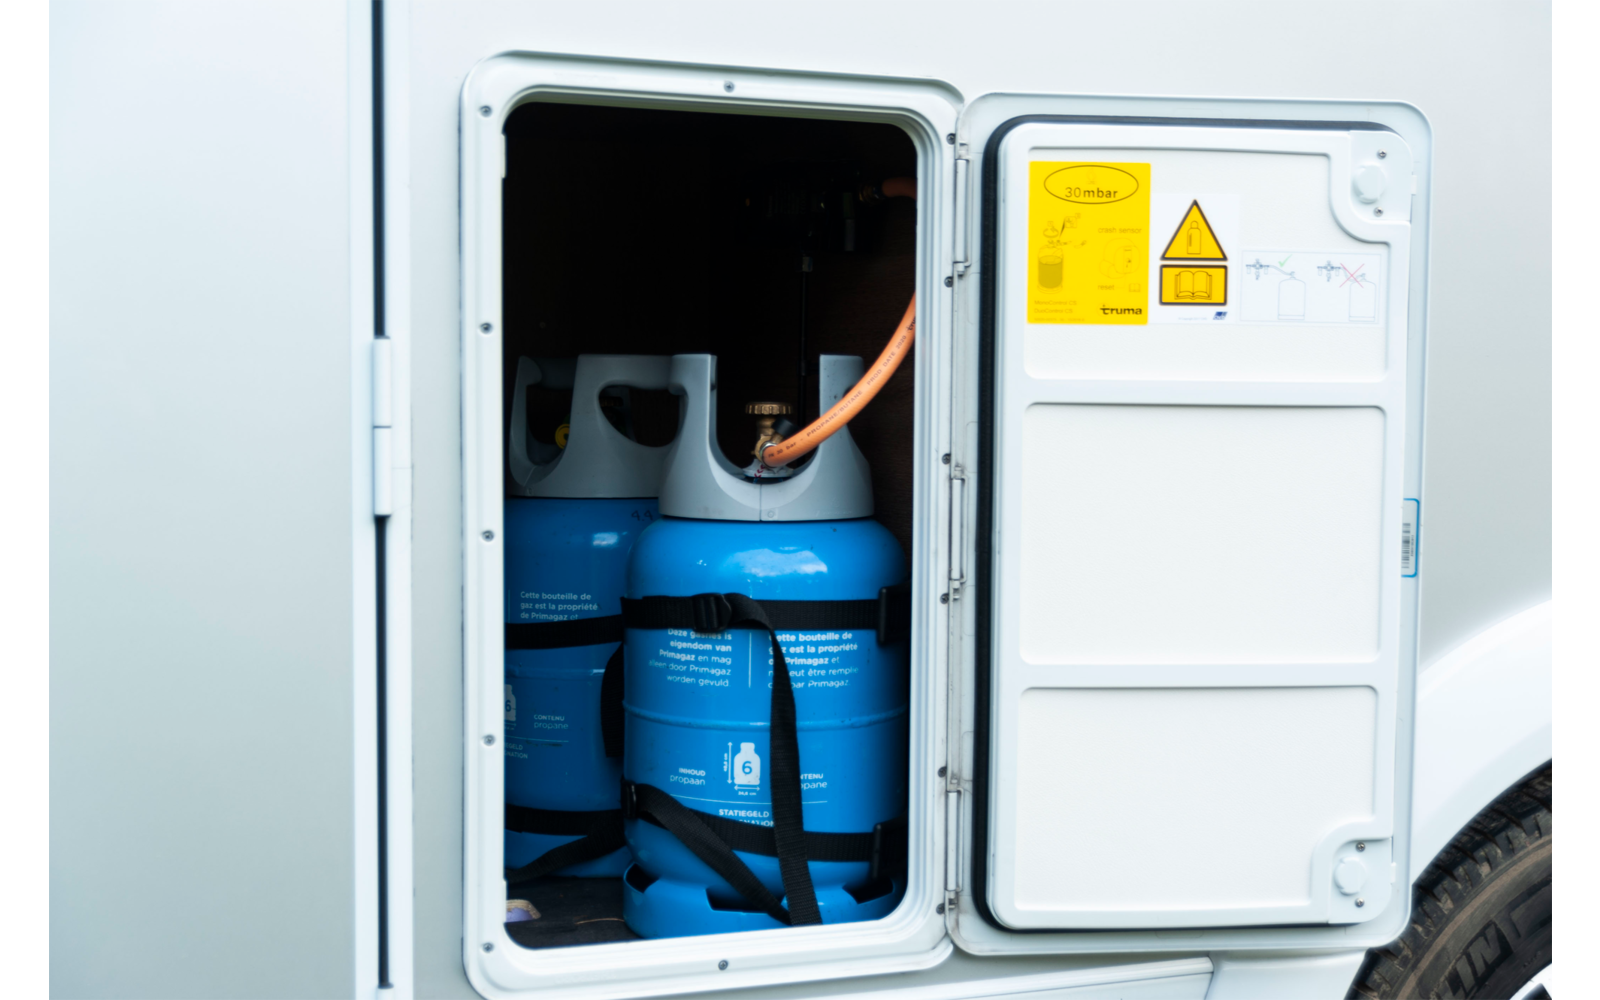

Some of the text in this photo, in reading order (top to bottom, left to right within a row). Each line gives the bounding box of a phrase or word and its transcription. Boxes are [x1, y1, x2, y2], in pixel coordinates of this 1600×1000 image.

[1100, 306, 1142, 315] truma
[786, 442, 796, 450] bar
[806, 390, 862, 437] PROPANE/BUTANE
[866, 368, 882, 386] PROD
[882, 351, 896, 368] DATE
[896, 335, 906, 350] 2020
[520, 591, 540, 599] Cette
[558, 603, 598, 611] propriété
[531, 612, 568, 621] Primagaz
[724, 632, 732, 640] is
[799, 632, 840, 642] bouteille
[670, 640, 712, 650] eigendom
[768, 642, 858, 655] gz est la propriété
[660, 649, 696, 661] Primagaz
[711, 656, 732, 665] mag
[784, 657, 829, 666] Primagaz
[668, 662, 687, 671] door
[690, 664, 731, 676] Primagaz
[808, 668, 826, 677] être
[828, 666, 858, 676] remplie
[666, 674, 696, 684] worden
[679, 768, 706, 776] INHOUD
[742, 760, 752, 774] 6
[670, 775, 705, 785] propaan
[719, 809, 770, 818] STATIEGELD
